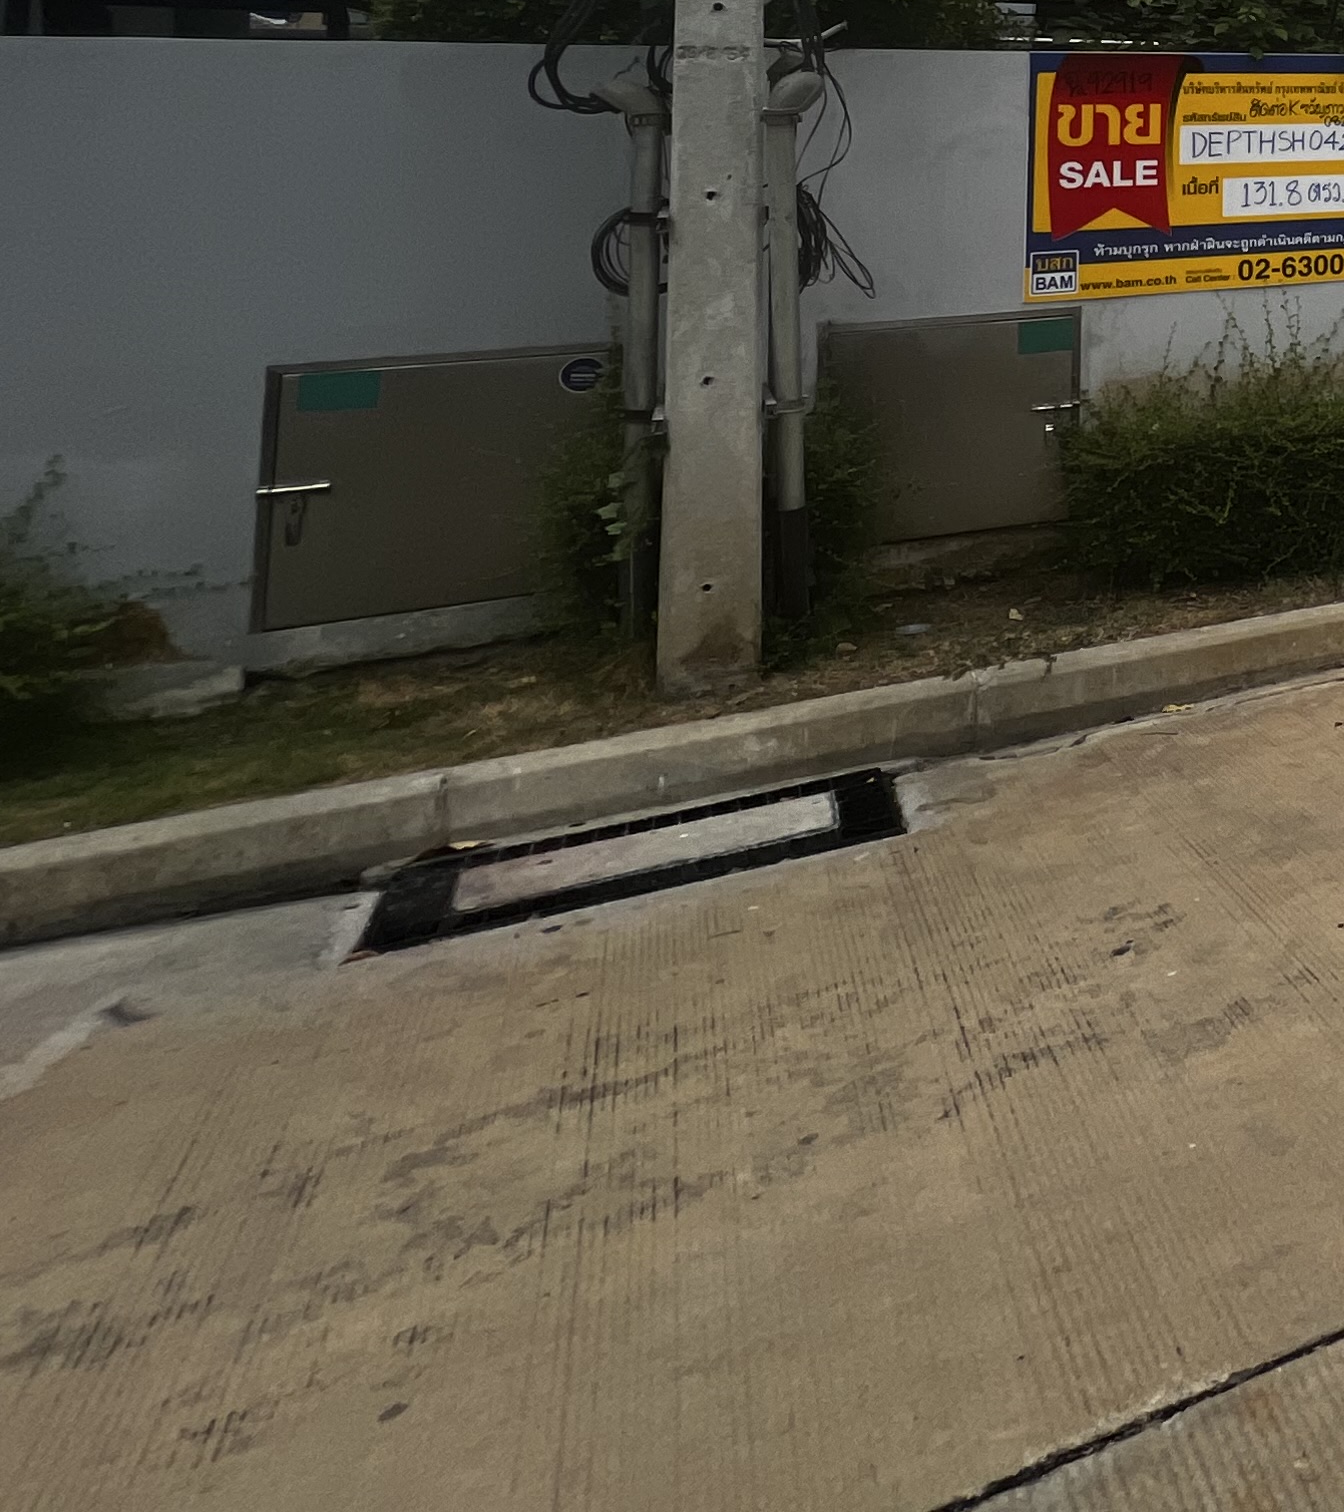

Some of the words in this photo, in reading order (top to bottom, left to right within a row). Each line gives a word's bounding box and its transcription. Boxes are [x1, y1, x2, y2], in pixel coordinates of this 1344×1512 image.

[1057, 103, 1161, 147] ขาย
[1058, 159, 1159, 189] SALE
[1182, 175, 1219, 196] เนื้อที่
[1240, 179, 1302, 208] 131.8
[1093, 242, 1158, 259] ห้ามบุกรุก
[1035, 255, 1074, 272] บสก
[1035, 274, 1074, 291] BAM
[1079, 274, 1177, 291] www.bam.co.th
